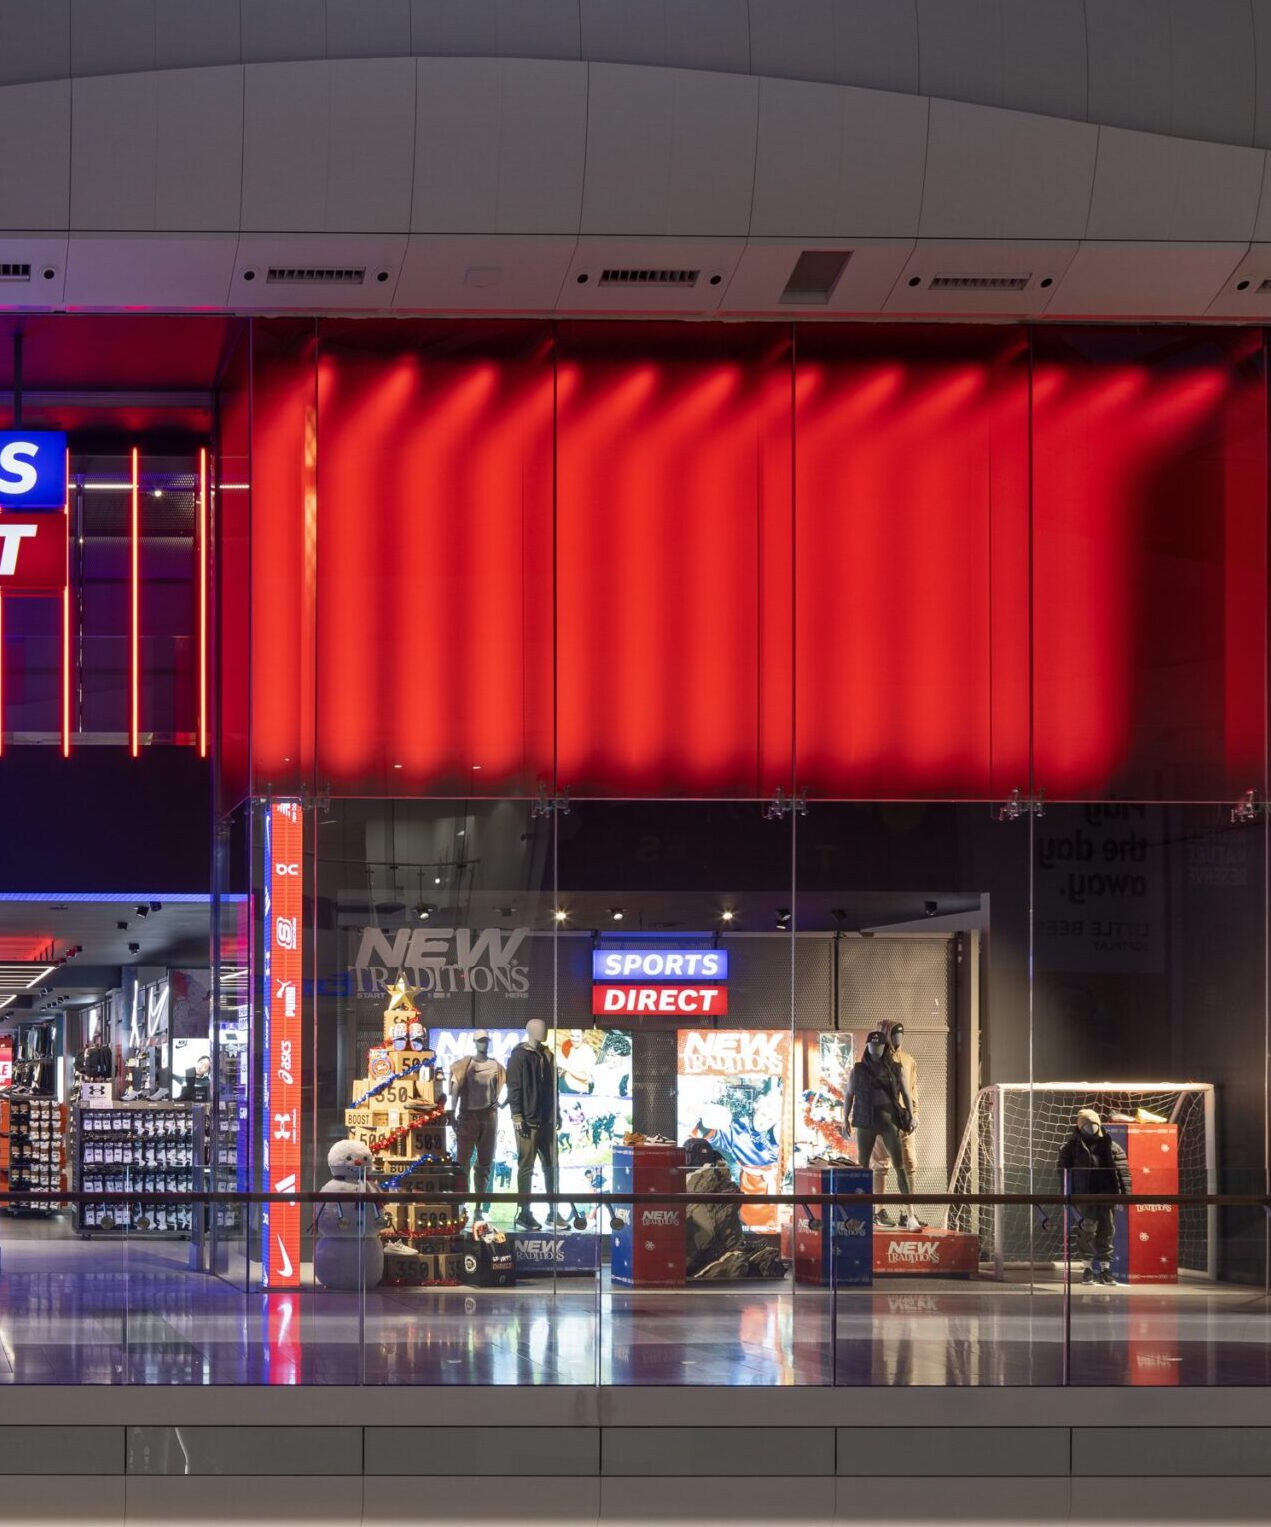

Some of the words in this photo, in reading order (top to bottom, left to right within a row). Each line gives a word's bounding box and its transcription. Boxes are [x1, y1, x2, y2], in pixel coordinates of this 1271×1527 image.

[355, 926, 530, 967] NEW
[604, 954, 719, 976] SPORTS
[348, 966, 530, 992] TRADITIONS
[604, 989, 719, 1011] DIRECT
[685, 1032, 784, 1056] NEW
[281, 1040, 292, 1070] asics
[348, 1114, 371, 1125] BOOST
[642, 1211, 680, 1220] NEW
[514, 1240, 565, 1252] NEW
[888, 1241, 940, 1254] NEW
[516, 1250, 565, 1262] RADITIONS
[886, 1252, 940, 1263] TRADITIONS
